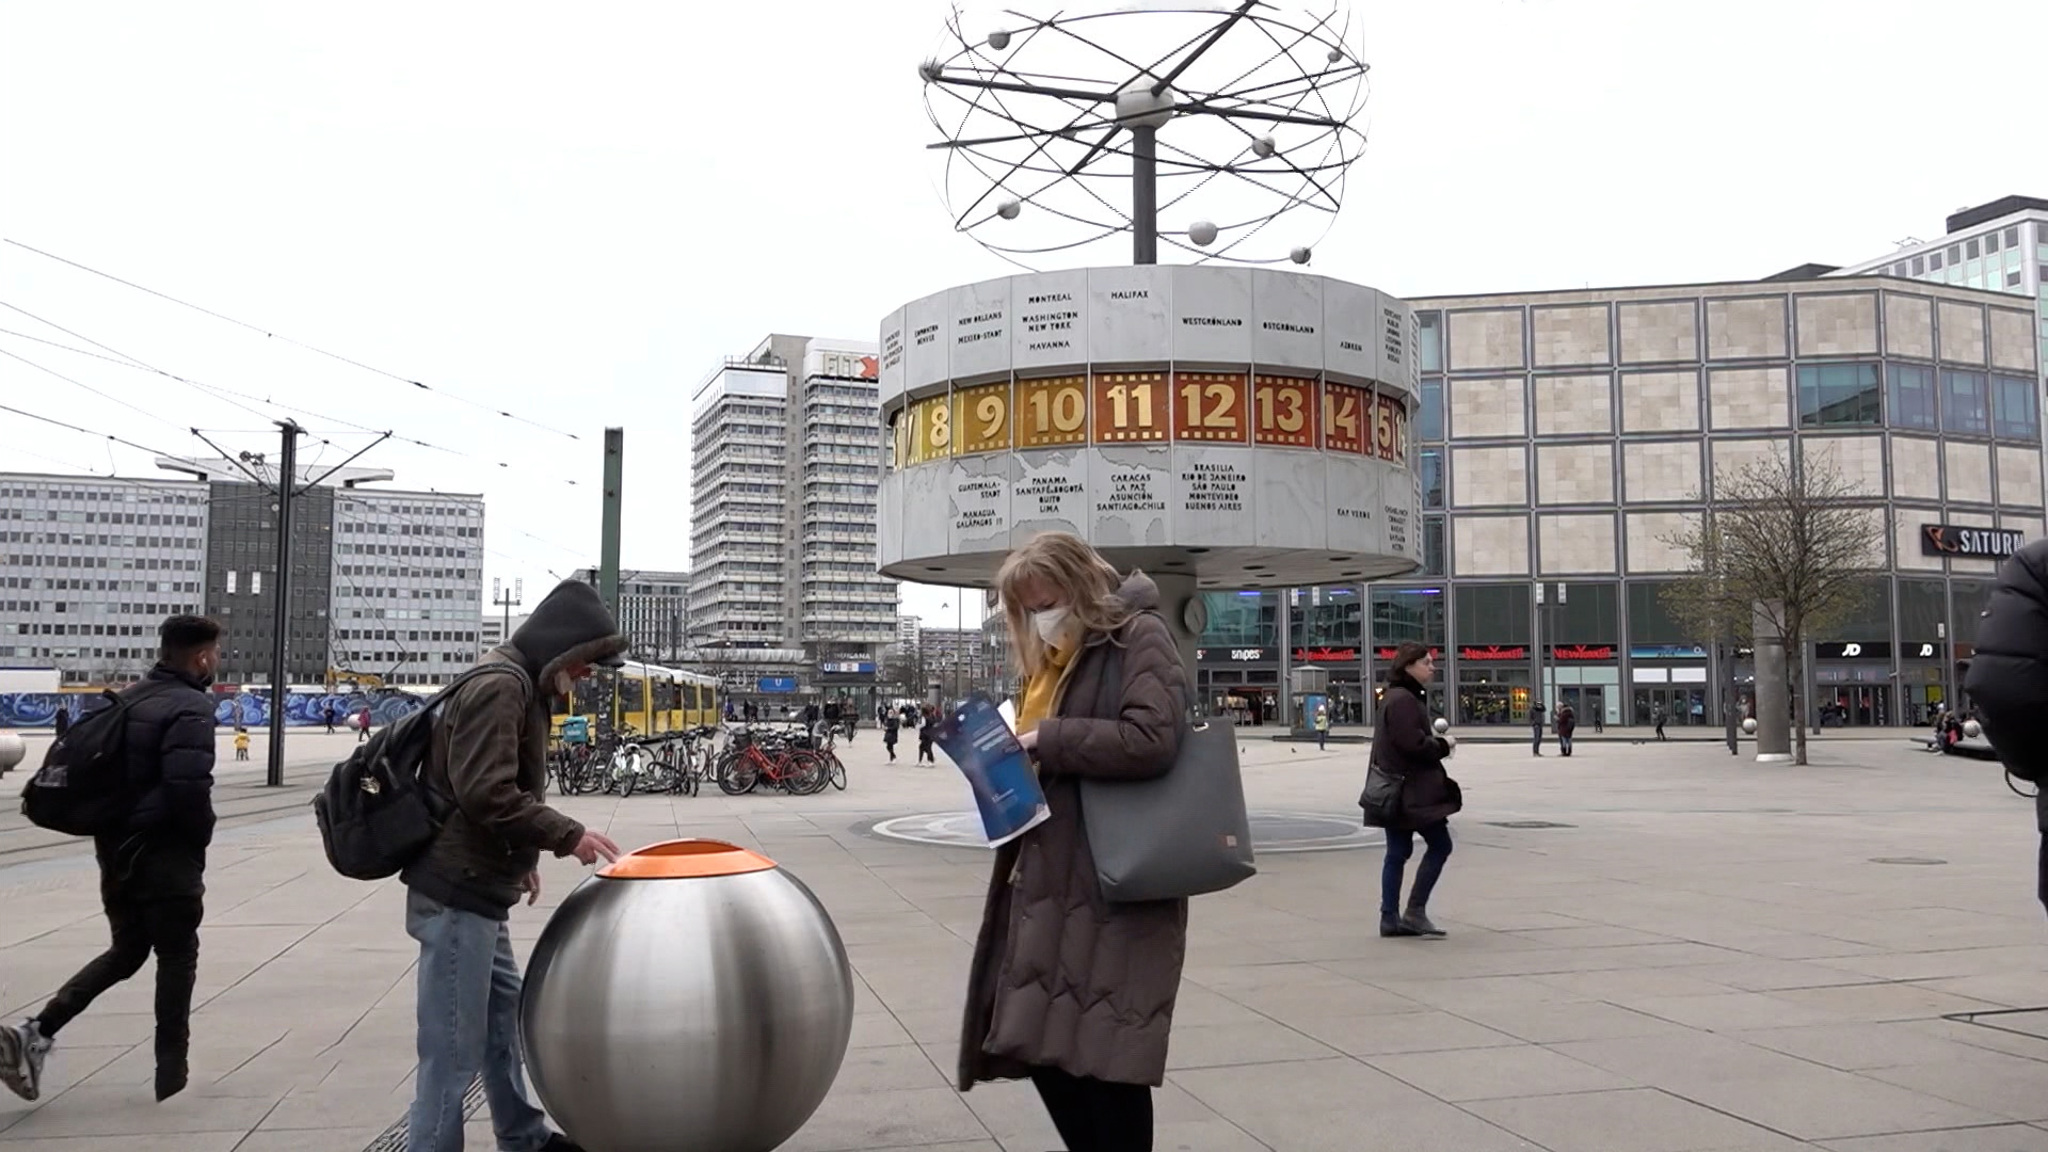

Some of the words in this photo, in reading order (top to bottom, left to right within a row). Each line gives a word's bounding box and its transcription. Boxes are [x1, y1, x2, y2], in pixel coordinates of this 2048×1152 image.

[1028, 293, 1072, 304] MONTREAL
[1111, 290, 1149, 300] HALIFAX
[958, 317, 972, 326] NEW
[974, 311, 1003, 323] ORLEANS
[1022, 311, 1079, 324] WASHINGTON
[1028, 323, 1047, 333] NEW
[1053, 321, 1072, 331] YORK
[1029, 340, 1071, 350] HAVANNA
[1029, 387, 1086, 433] 10
[1106, 384, 1152, 429] 11
[1180, 383, 1236, 428] 12
[1255, 387, 1304, 433] 13
[976, 395, 1006, 439] 9
[1324, 393, 1356, 439] 14
[930, 404, 949, 447] 8
[1194, 464, 1234, 472] BRASILIA
[1032, 476, 1067, 485] PANAMA
[1111, 473, 1151, 482] CARACAS
[1182, 473, 1195, 481] RIO
[1198, 473, 1207, 481] DE
[1210, 473, 1246, 482] JANEIRO
[1116, 484, 1126, 492] LA
[1130, 482, 1146, 491] PAZ
[1211, 483, 1236, 491] PAULO
[980, 489, 1001, 499] STADT
[1039, 495, 1061, 503] QUITO
[1189, 492, 1239, 501] MONTEVIDEO
[1040, 505, 1059, 513] LIMA
[1186, 502, 1216, 510] BUENOS
[1219, 502, 1242, 511] AIRES
[963, 508, 996, 519] MANAGUA
[1961, 530, 2024, 555] SATURN
[1842, 644, 1861, 656] JD
[1920, 644, 1933, 656] JD
[775, 678, 782, 687] U
